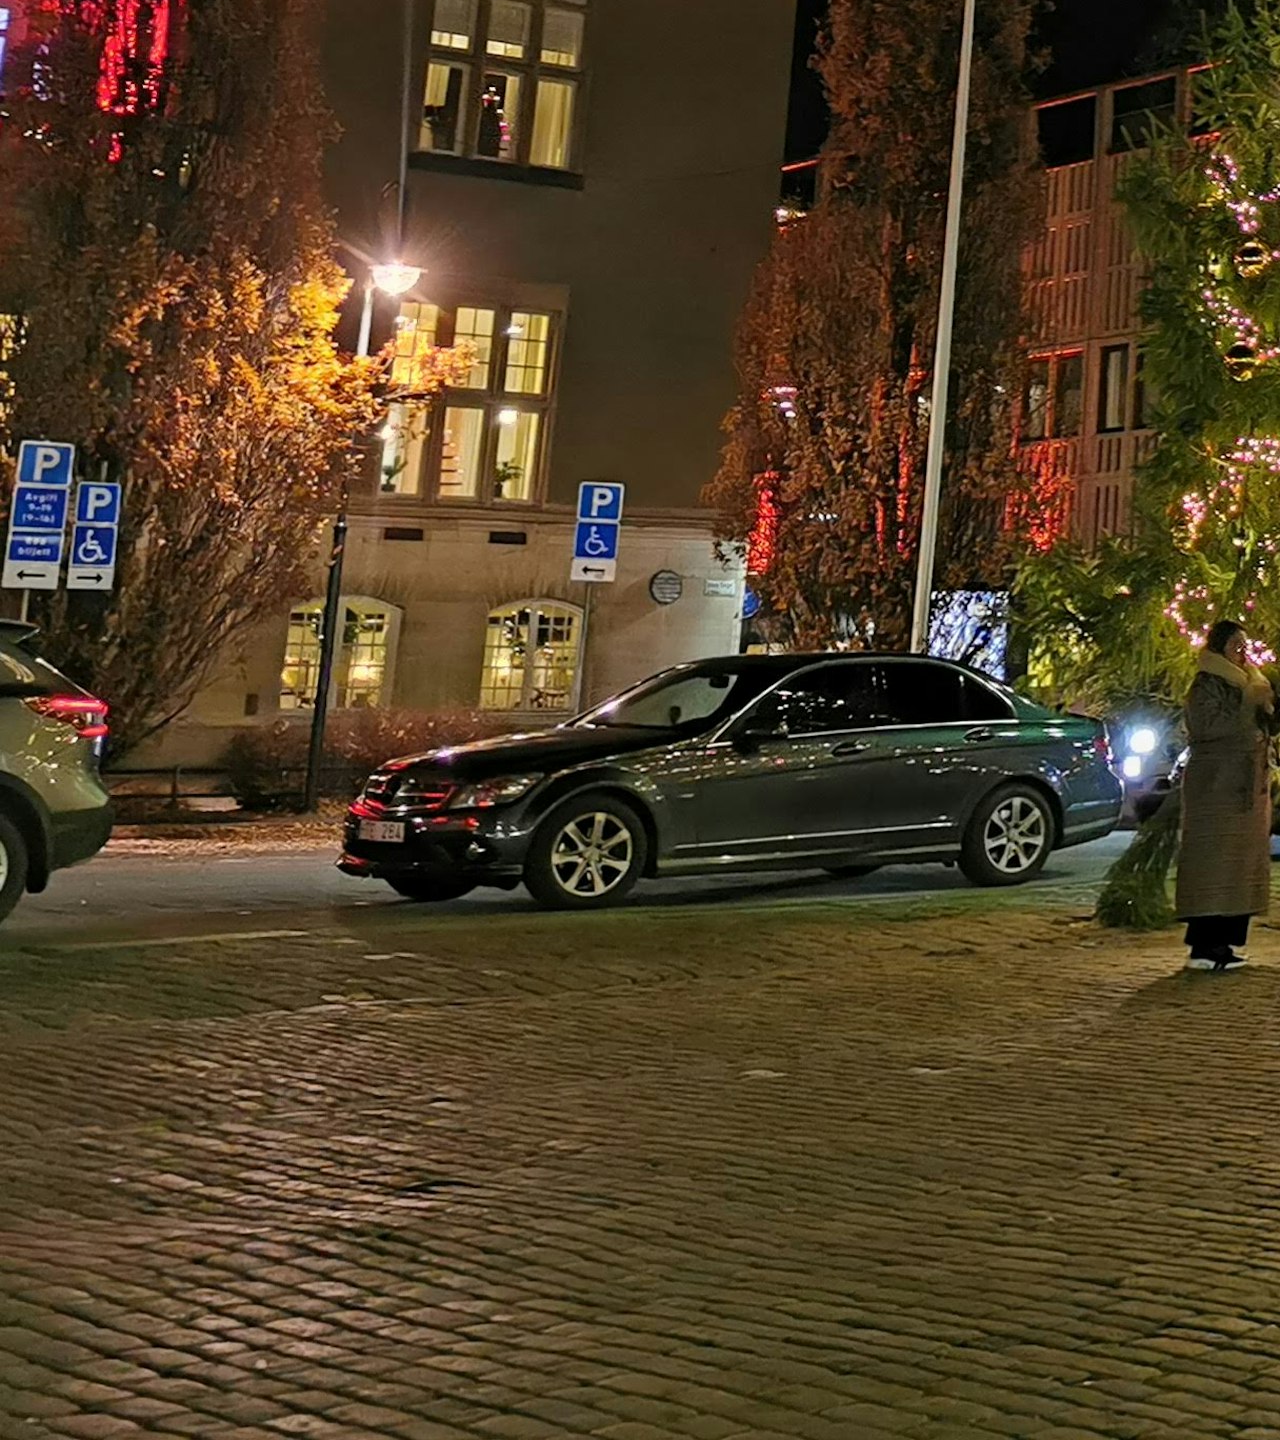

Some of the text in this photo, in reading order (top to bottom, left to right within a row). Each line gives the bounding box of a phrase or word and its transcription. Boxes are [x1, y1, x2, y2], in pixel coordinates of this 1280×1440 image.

[33, 447, 61, 481] P
[86, 487, 112, 520] P
[591, 487, 613, 516] P
